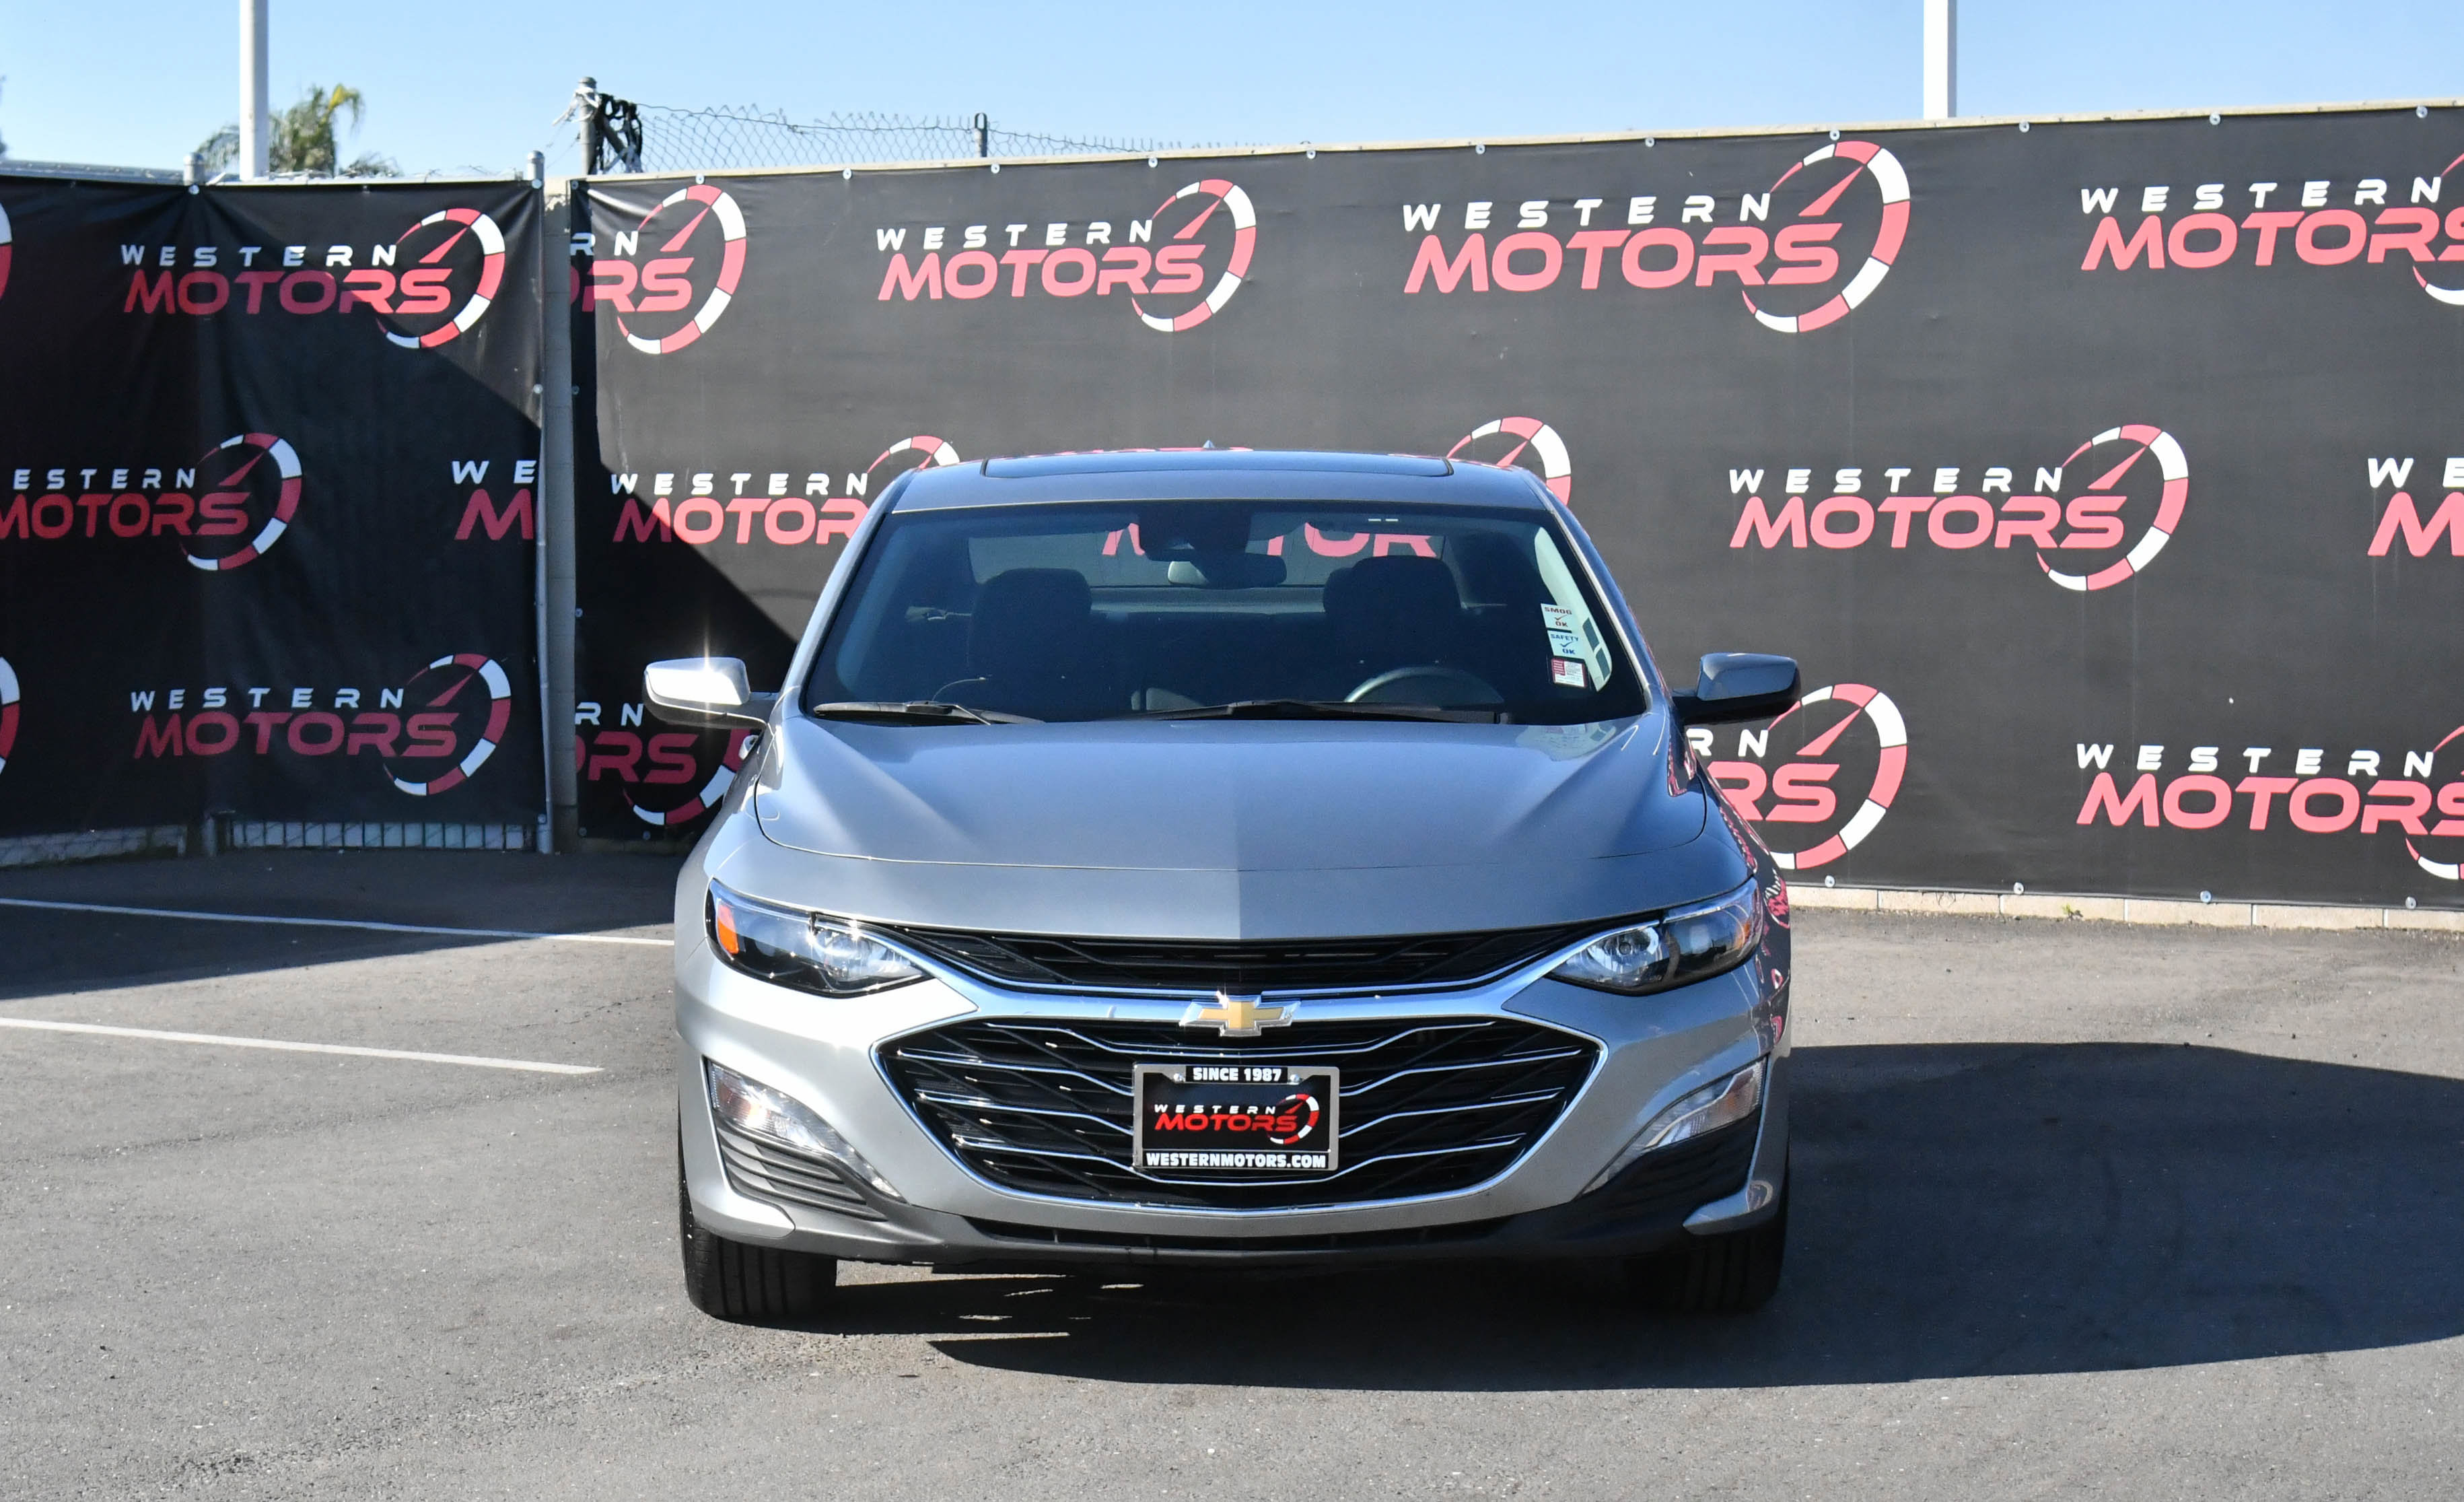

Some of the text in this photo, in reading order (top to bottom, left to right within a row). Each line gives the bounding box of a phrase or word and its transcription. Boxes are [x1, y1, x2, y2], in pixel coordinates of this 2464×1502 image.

[2080, 176, 2442, 214] WESTERN
[1403, 193, 1771, 232] WESTERN
[876, 219, 1153, 251] WESTERN
[120, 244, 397, 267] WESTERN
[1404, 222, 1843, 294] MOTORS
[878, 243, 1207, 302] MOTORS
[124, 268, 453, 315] MOTORS
[12, 468, 196, 490] ESTERN
[610, 473, 868, 496] WESTERN
[1729, 467, 2063, 494] WESTERN
[0, 493, 249, 539] MOTORS
[613, 496, 869, 546] MOTOR
[1730, 495, 2127, 549] MOTORS
[1544, 607, 1572, 615] SMOG
[1550, 634, 1579, 642] SAFETY
[131, 687, 404, 712] WESTERN
[134, 712, 459, 757] MOTORS
[2076, 743, 2434, 778] WESTERN
[1193, 1067, 1282, 1082] SINCE 1987
[1154, 1104, 1276, 1115] WESTERN
[1154, 1114, 1298, 1132] MOTORS
[1146, 1152, 1326, 1169] WESTERNMOTORS.COM
